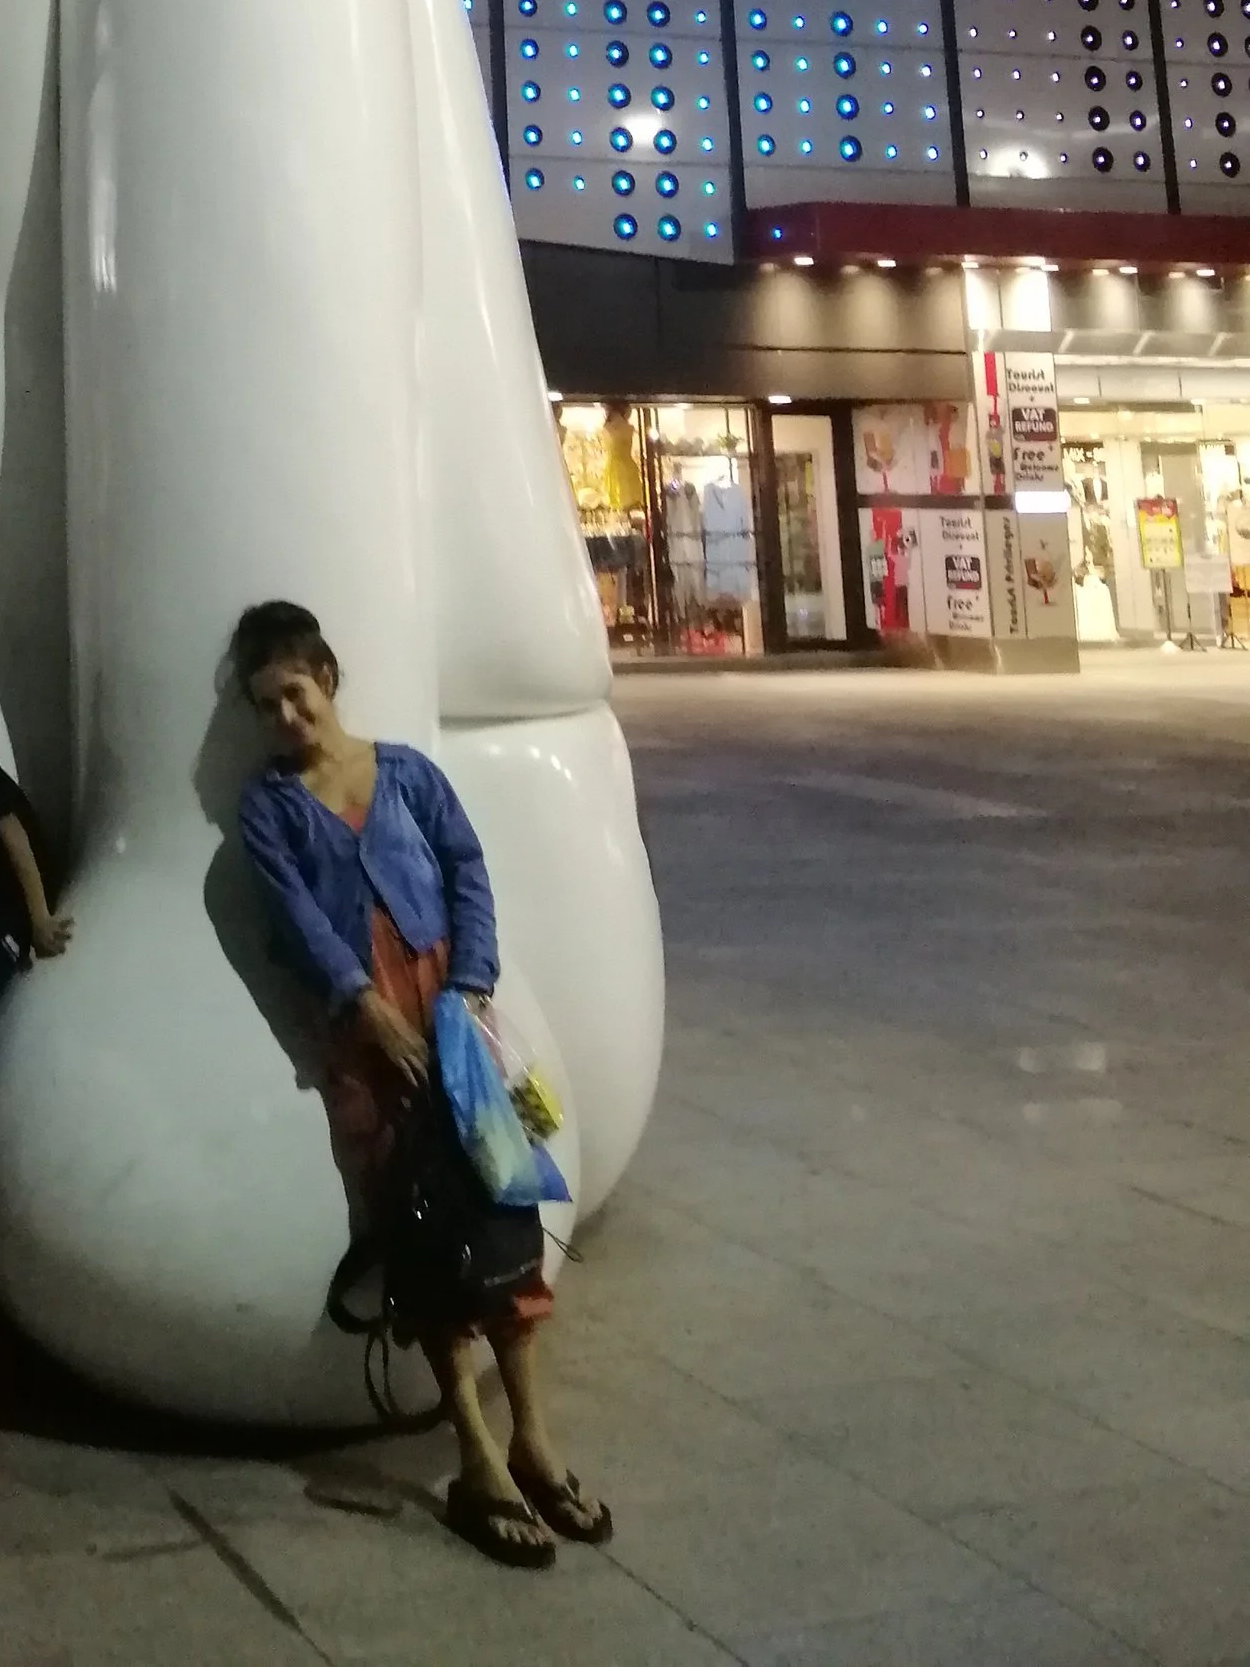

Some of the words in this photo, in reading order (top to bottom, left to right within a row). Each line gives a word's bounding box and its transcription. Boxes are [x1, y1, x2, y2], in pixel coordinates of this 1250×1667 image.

[1021, 408, 1046, 421] VAT
[1014, 420, 1054, 433] REFUND
[951, 556, 973, 570] VAT
